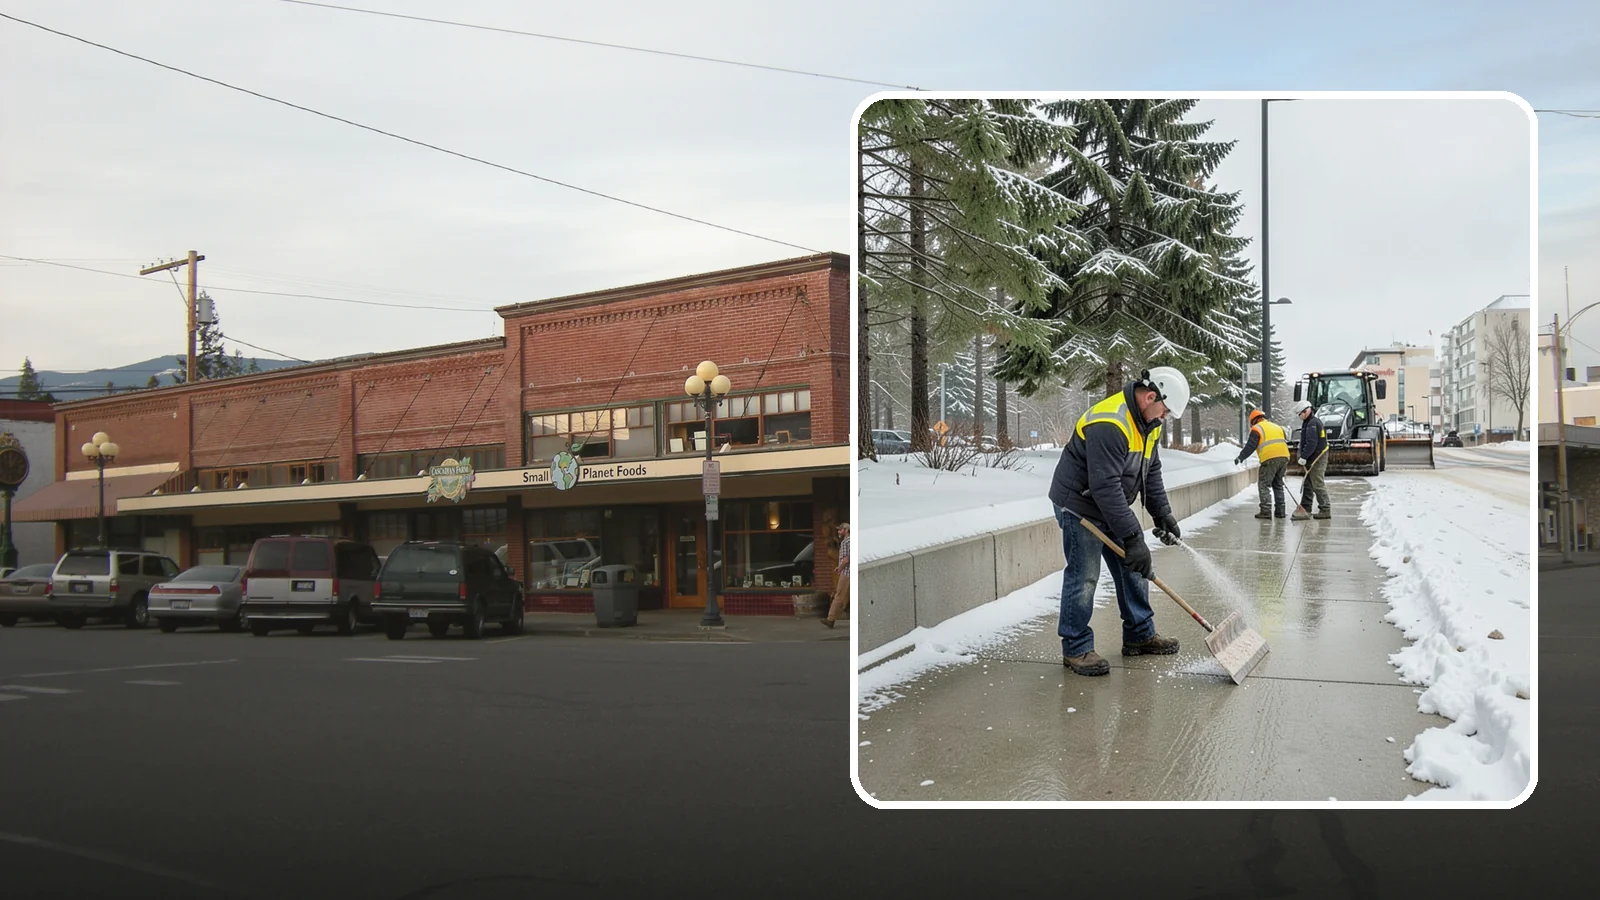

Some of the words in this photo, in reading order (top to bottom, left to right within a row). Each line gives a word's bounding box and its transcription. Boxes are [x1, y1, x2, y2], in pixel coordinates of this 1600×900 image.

[523, 471, 549, 483] Small
[583, 467, 614, 479] Planet
[617, 464, 647, 476] Foods
